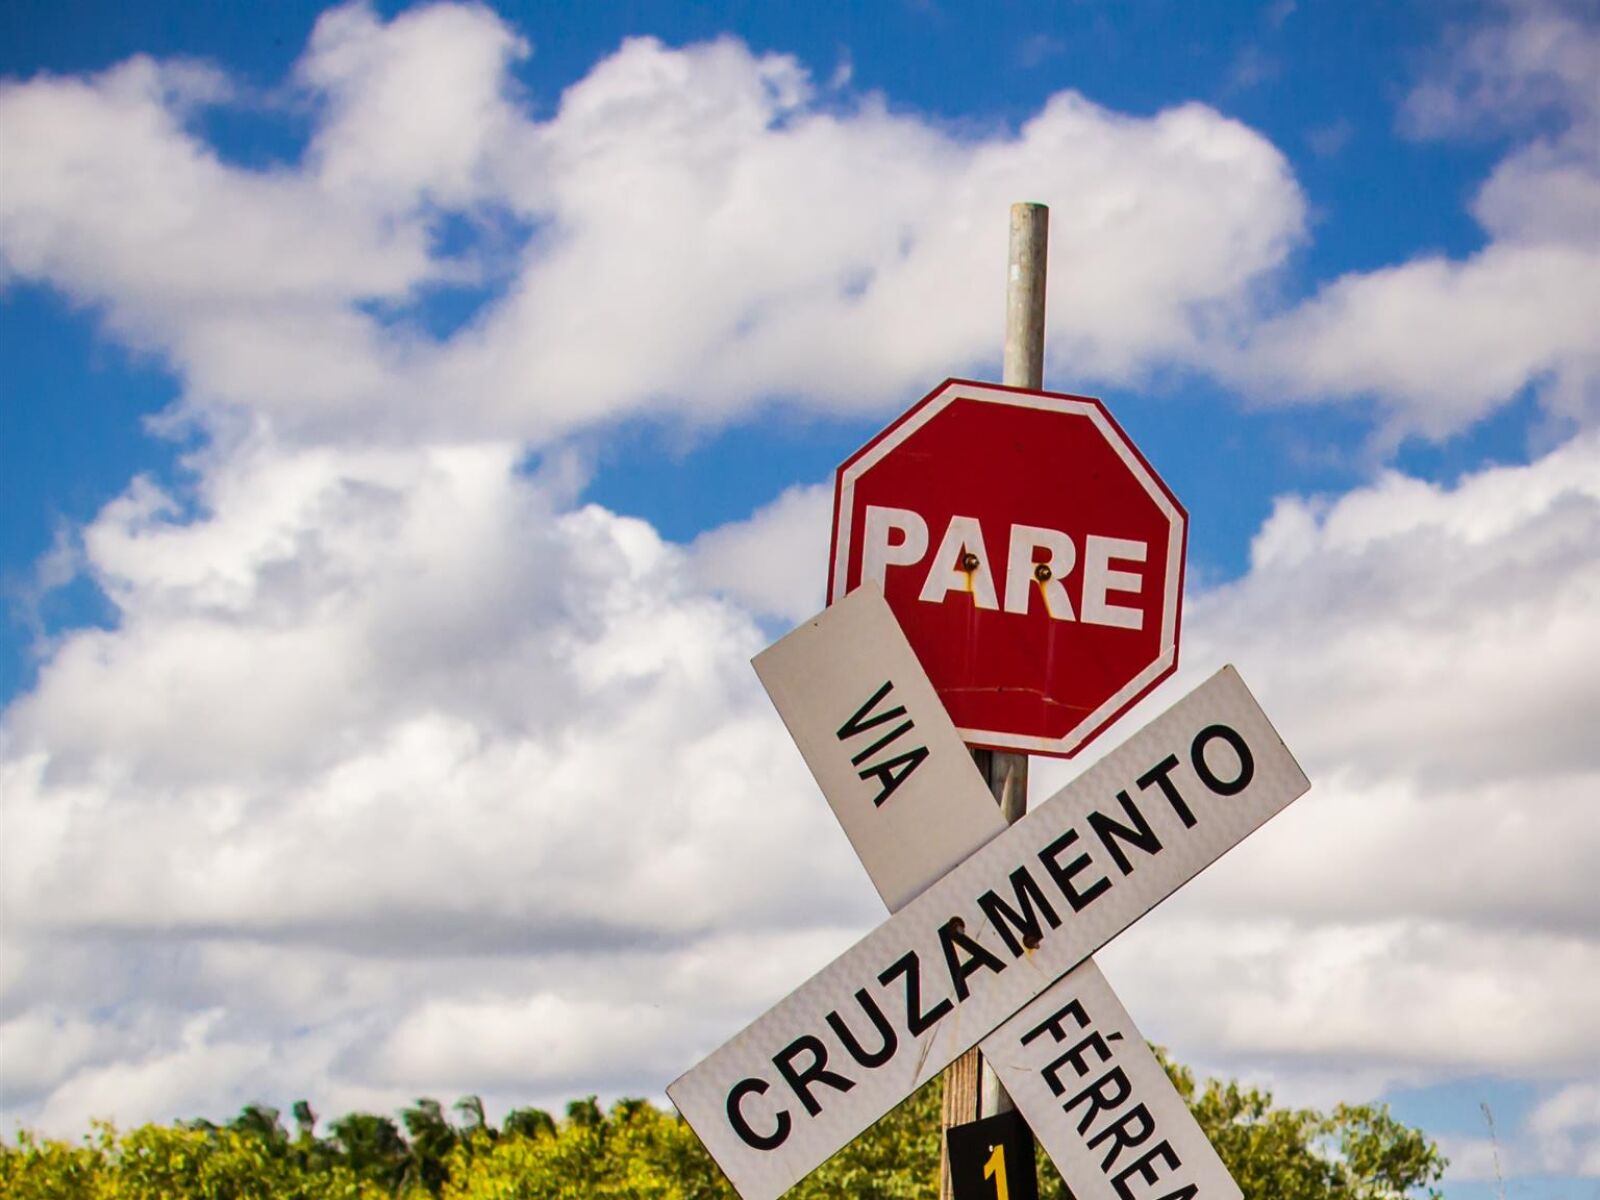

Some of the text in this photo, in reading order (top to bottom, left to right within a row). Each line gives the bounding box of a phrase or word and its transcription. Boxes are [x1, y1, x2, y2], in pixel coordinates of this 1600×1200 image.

[860, 505, 1148, 630] PARE
[836, 680, 930, 808] VIA
[726, 723, 1255, 1151] CRUZAMENTO
